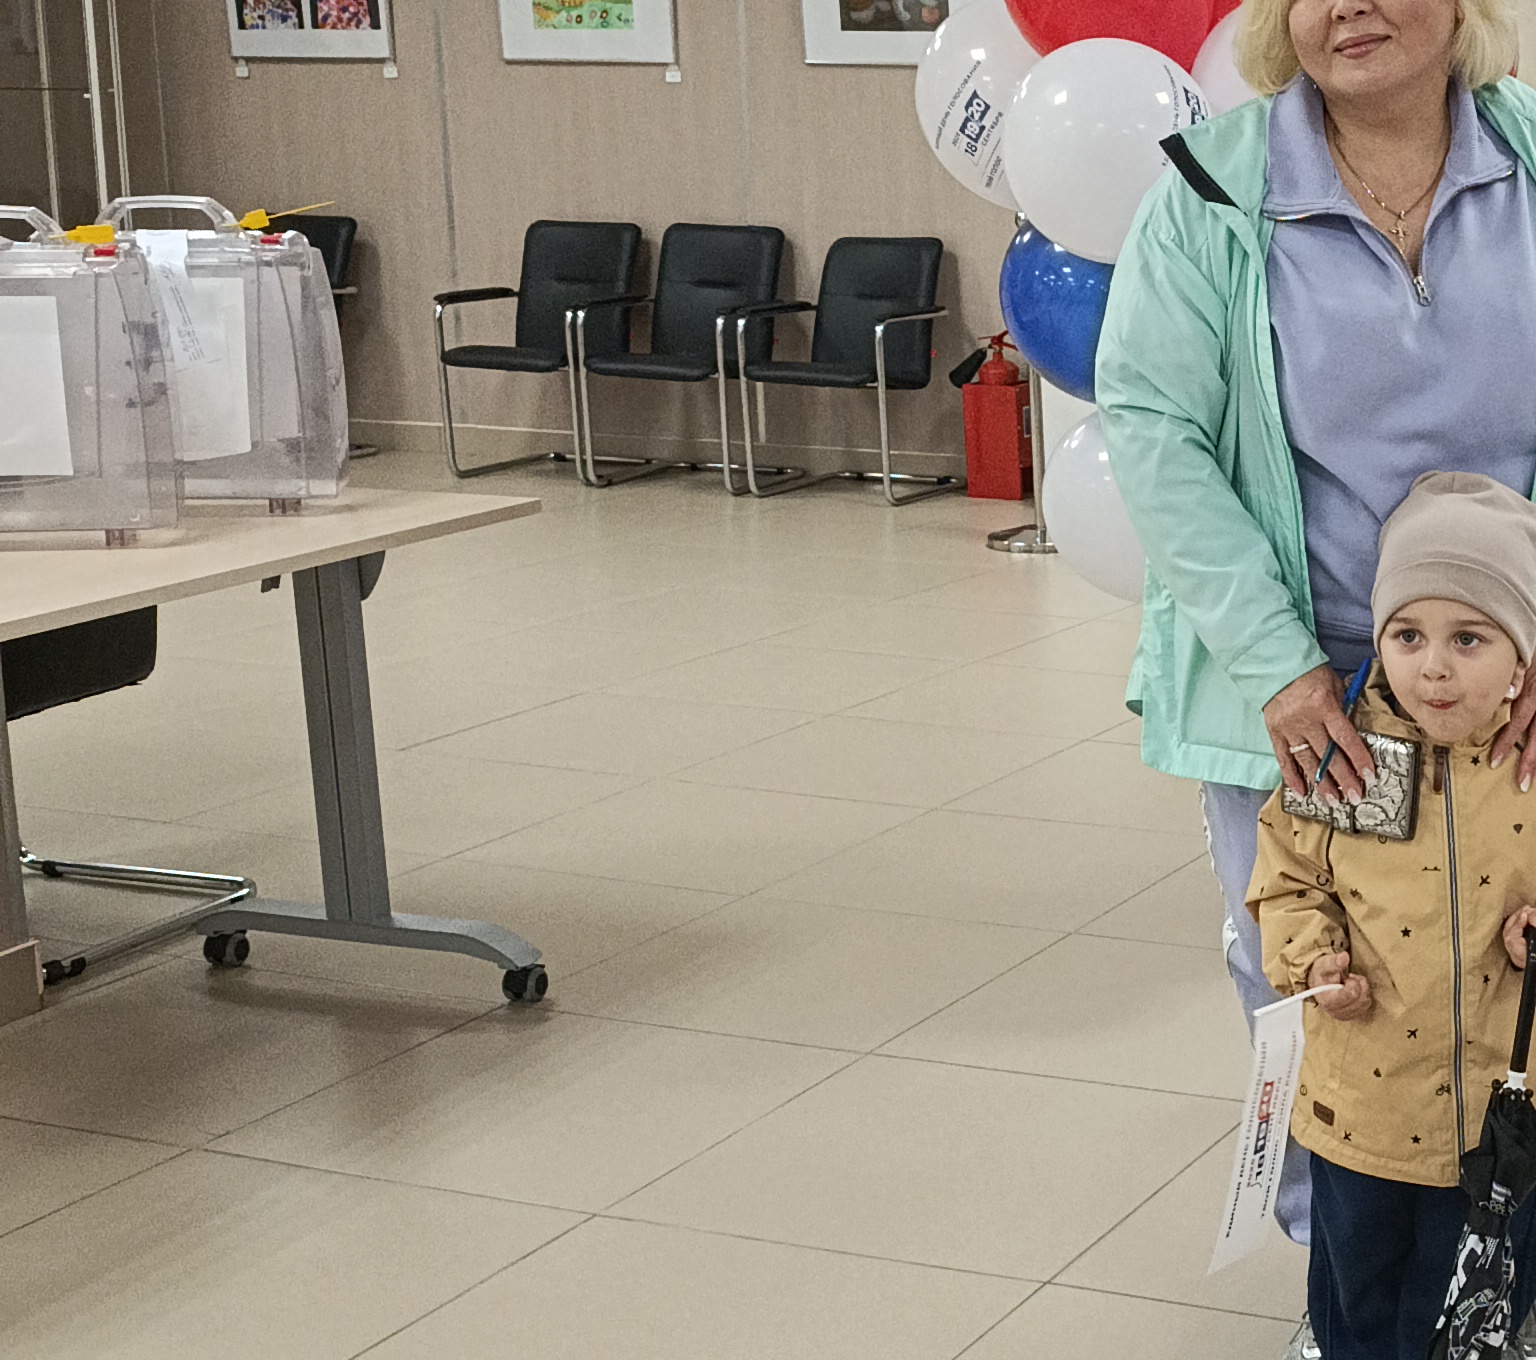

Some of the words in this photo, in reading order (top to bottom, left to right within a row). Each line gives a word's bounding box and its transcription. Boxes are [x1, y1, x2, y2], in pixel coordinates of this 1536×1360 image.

[967, 98, 985, 121] 20
[964, 121, 981, 139] 19
[964, 141, 978, 157] 18
